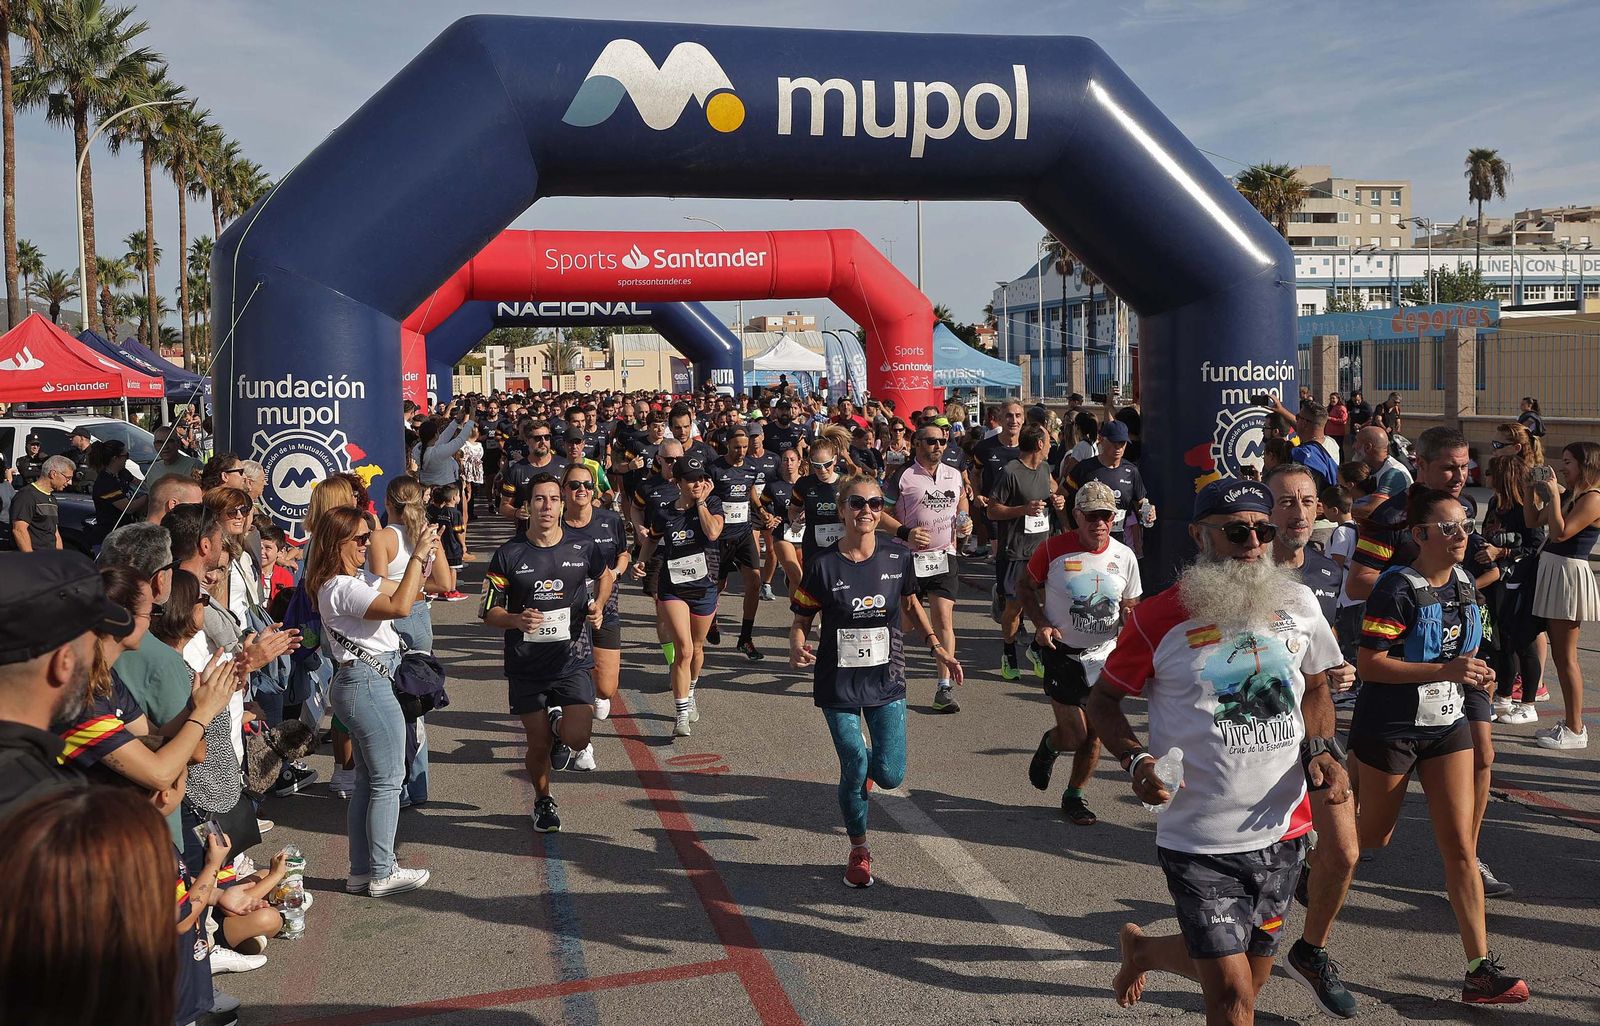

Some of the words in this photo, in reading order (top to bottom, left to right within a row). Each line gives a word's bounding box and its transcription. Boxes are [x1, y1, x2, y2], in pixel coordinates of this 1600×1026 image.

[777, 65, 1029, 158] mupol
[545, 249, 617, 274] Sports
[654, 248, 767, 268] Santander
[1526, 260, 1555, 272] CON
[617, 277, 692, 287] sportssantander.es
[497, 301, 652, 317] NACIONAL
[1392, 306, 1490, 336] deportes
[894, 345, 925, 357] Sports
[711, 369, 735, 384] RUTA
[1201, 360, 1294, 382] fundación
[57, 382, 109, 392] Santander
[237, 373, 365, 399] fundación
[257, 401, 340, 430] mupol
[264, 452, 279, 482] undación
[298, 444, 332, 467] Mutualidad
[682, 568, 697, 577] 520
[534, 579, 564, 592] 200
[851, 594, 886, 612] 200
[539, 627, 557, 636] 359
[341, 640, 360, 655] LOLA
[360, 652, 381, 671] BIMBA
[858, 649, 871, 657] 51
[1441, 704, 1454, 716] 93
[1219, 720, 1250, 747] Vive
[1251, 716, 1268, 745] la
[1269, 713, 1296, 744] vida
[1248, 745, 1256, 753] de
[1258, 743, 1265, 752] la
